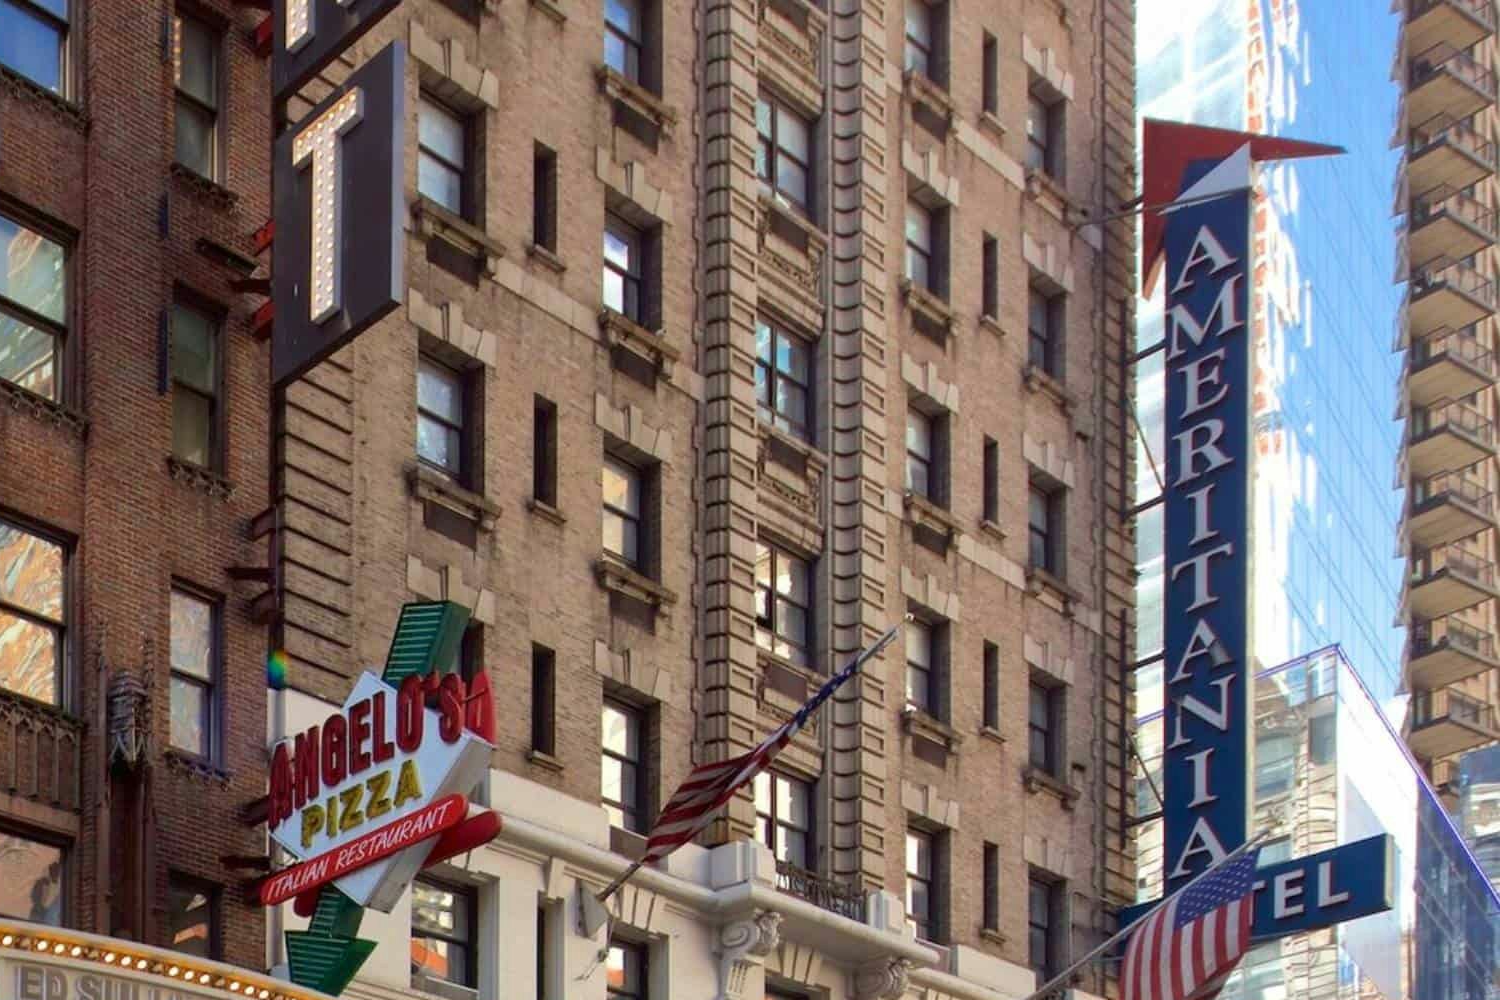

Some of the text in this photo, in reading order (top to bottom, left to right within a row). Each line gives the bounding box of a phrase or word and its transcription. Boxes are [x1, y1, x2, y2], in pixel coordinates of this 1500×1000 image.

[1167, 225, 1244, 880] AMERITANIA
[268, 671, 467, 835] ANGELO'S
[300, 759, 423, 850] PIZZA
[266, 800, 454, 900] ITALIAN RESTAURANT
